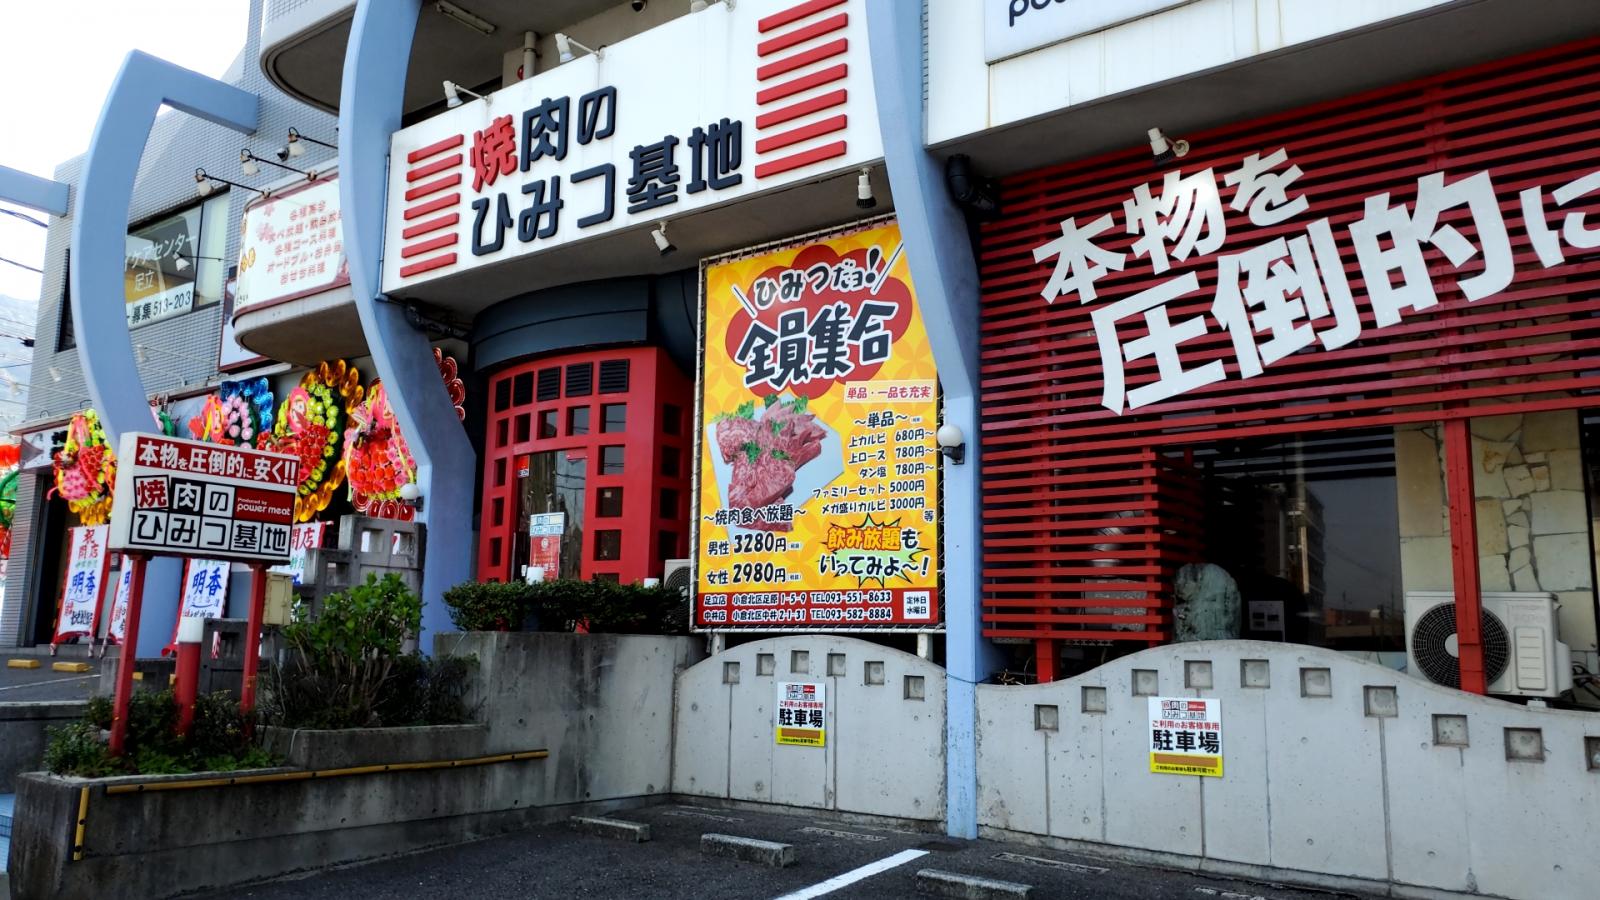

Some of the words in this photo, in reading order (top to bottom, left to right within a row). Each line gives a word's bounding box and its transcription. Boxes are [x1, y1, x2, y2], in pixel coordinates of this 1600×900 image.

[470, 86, 617, 192] 焼肉の
[471, 118, 743, 256] ひみつ基地
[1032, 147, 1309, 304] 本物を
[1090, 170, 1600, 416] 圧倒的に
[737, 302, 897, 387] 全員集合
[848, 386, 932, 399] 単品・一品も充実
[848, 433, 886, 448] 上カルビ
[139, 441, 297, 485] 本物を圧倒的に安く!!
[848, 451, 886, 464] 上ロース
[859, 466, 887, 478] タン塩
[137, 479, 229, 512] 焼肉の
[813, 484, 885, 498] ファミリーセット
[890, 480, 925, 493] 5000円
[237, 503, 267, 513] power
[268, 506, 291, 516] meat
[822, 501, 885, 514] メガ盛りカルビ
[890, 497, 925, 509] 3000円
[137, 514, 286, 552] ひみつ基地
[708, 541, 729, 555] 男性
[734, 533, 786, 553] 3280円
[827, 527, 918, 551] 飲み放題も
[192, 567, 222, 596] 明香
[707, 570, 728, 584] 女性
[733, 562, 785, 583] 2980円
[704, 595, 726, 605] 足立店
[906, 596, 926, 604] 定休日
[704, 610, 726, 620] 中井店
[779, 708, 823, 728] 駐車場
[1153, 729, 1220, 753] 駐車場
